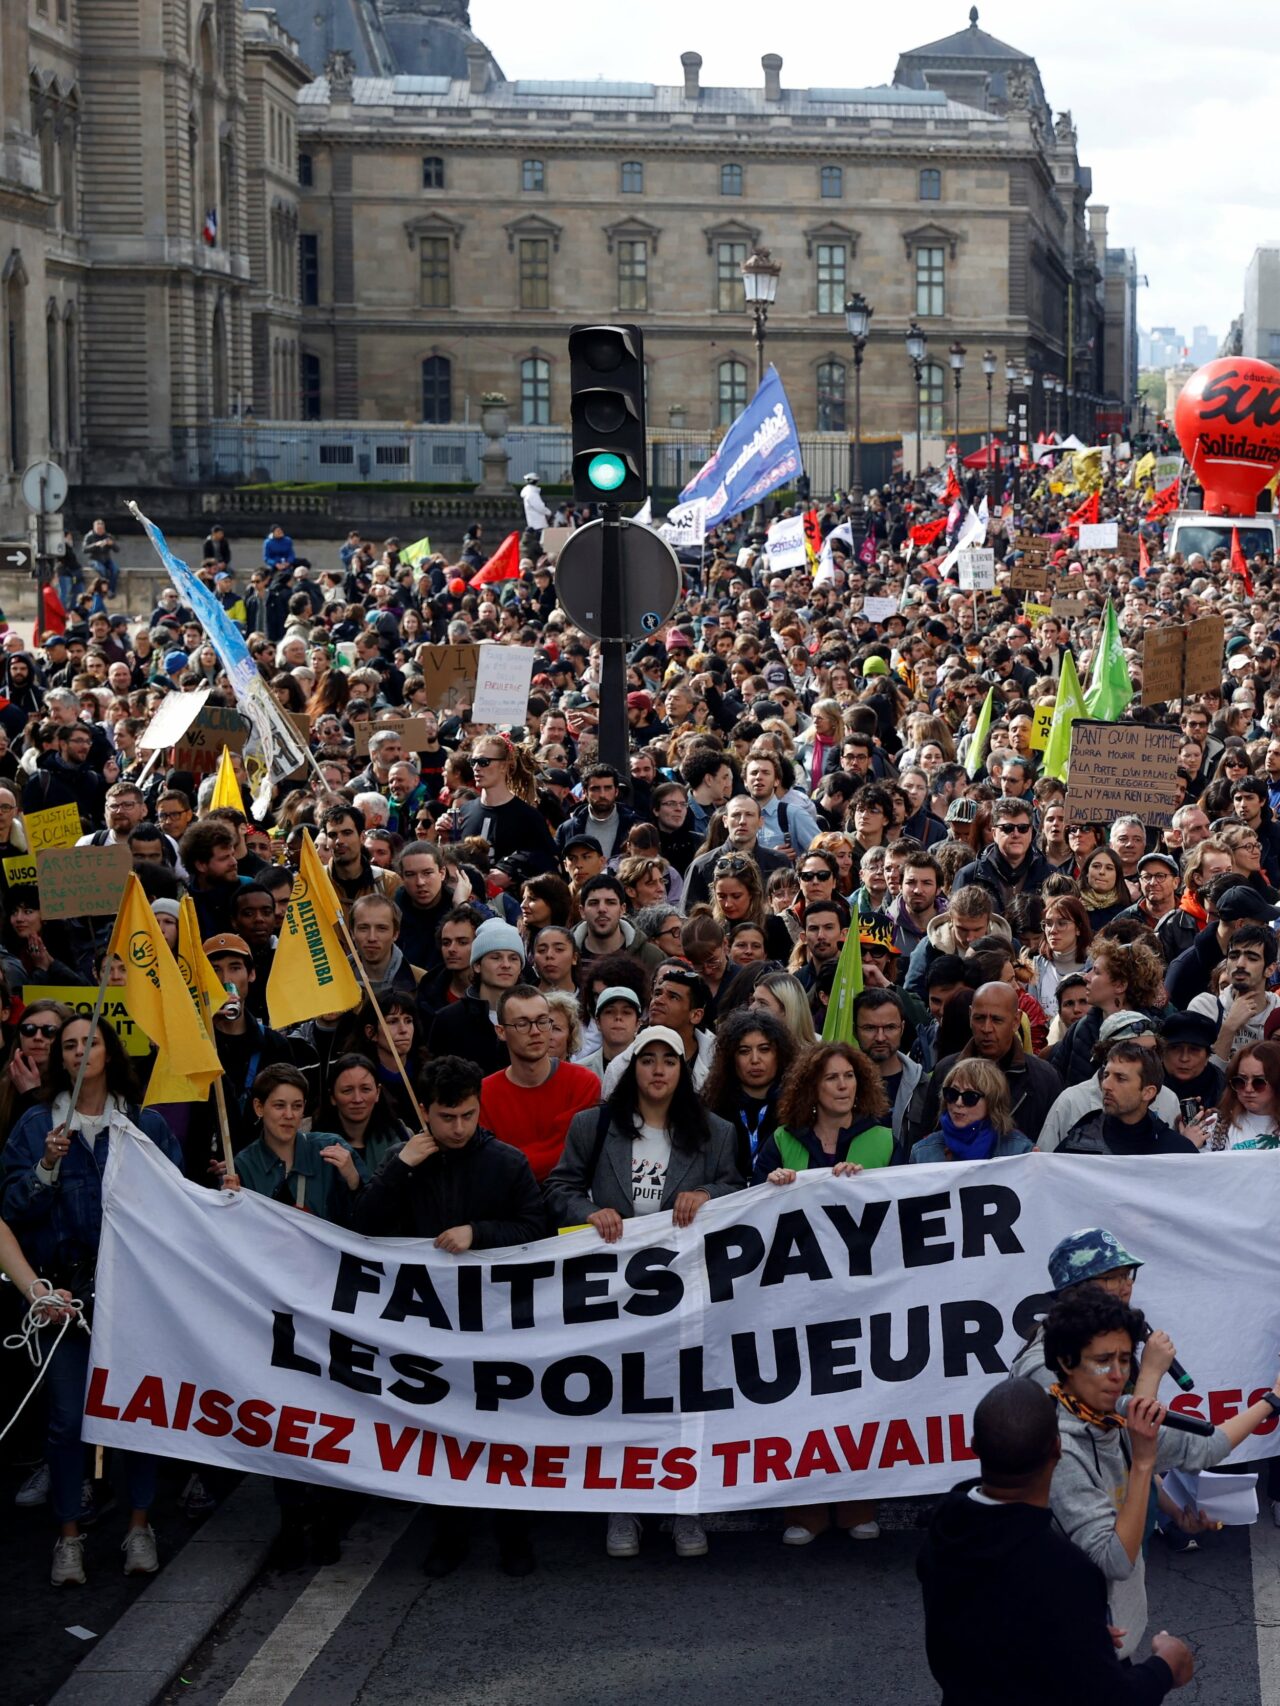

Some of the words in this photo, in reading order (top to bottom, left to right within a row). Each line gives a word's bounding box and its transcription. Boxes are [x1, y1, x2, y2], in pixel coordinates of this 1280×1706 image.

[1072, 727, 1107, 745] TANT
[1108, 729, 1139, 745] QU'UN
[1144, 734, 1180, 749] HOMME
[1071, 745, 1102, 757] POURRA
[1108, 750, 1135, 760] MOURIR
[1094, 763, 1117, 776] PORTE
[1089, 776, 1110, 785] TOUT
[32, 806, 77, 827] JUSTICE
[32, 822, 82, 848] SOCIALE
[9, 866, 37, 880] JUSQ
[296, 899, 335, 987] ALTERNATIBA
[633, 1187, 664, 1201] PUFF
[332, 1246, 686, 1334] FAITES
[704, 1183, 1026, 1304] PAYER
[271, 1310, 451, 1405] LES
[84, 1367, 355, 1466] LAISSEZ
[373, 1421, 571, 1490] VIVRE
[583, 1445, 697, 1492] LES
